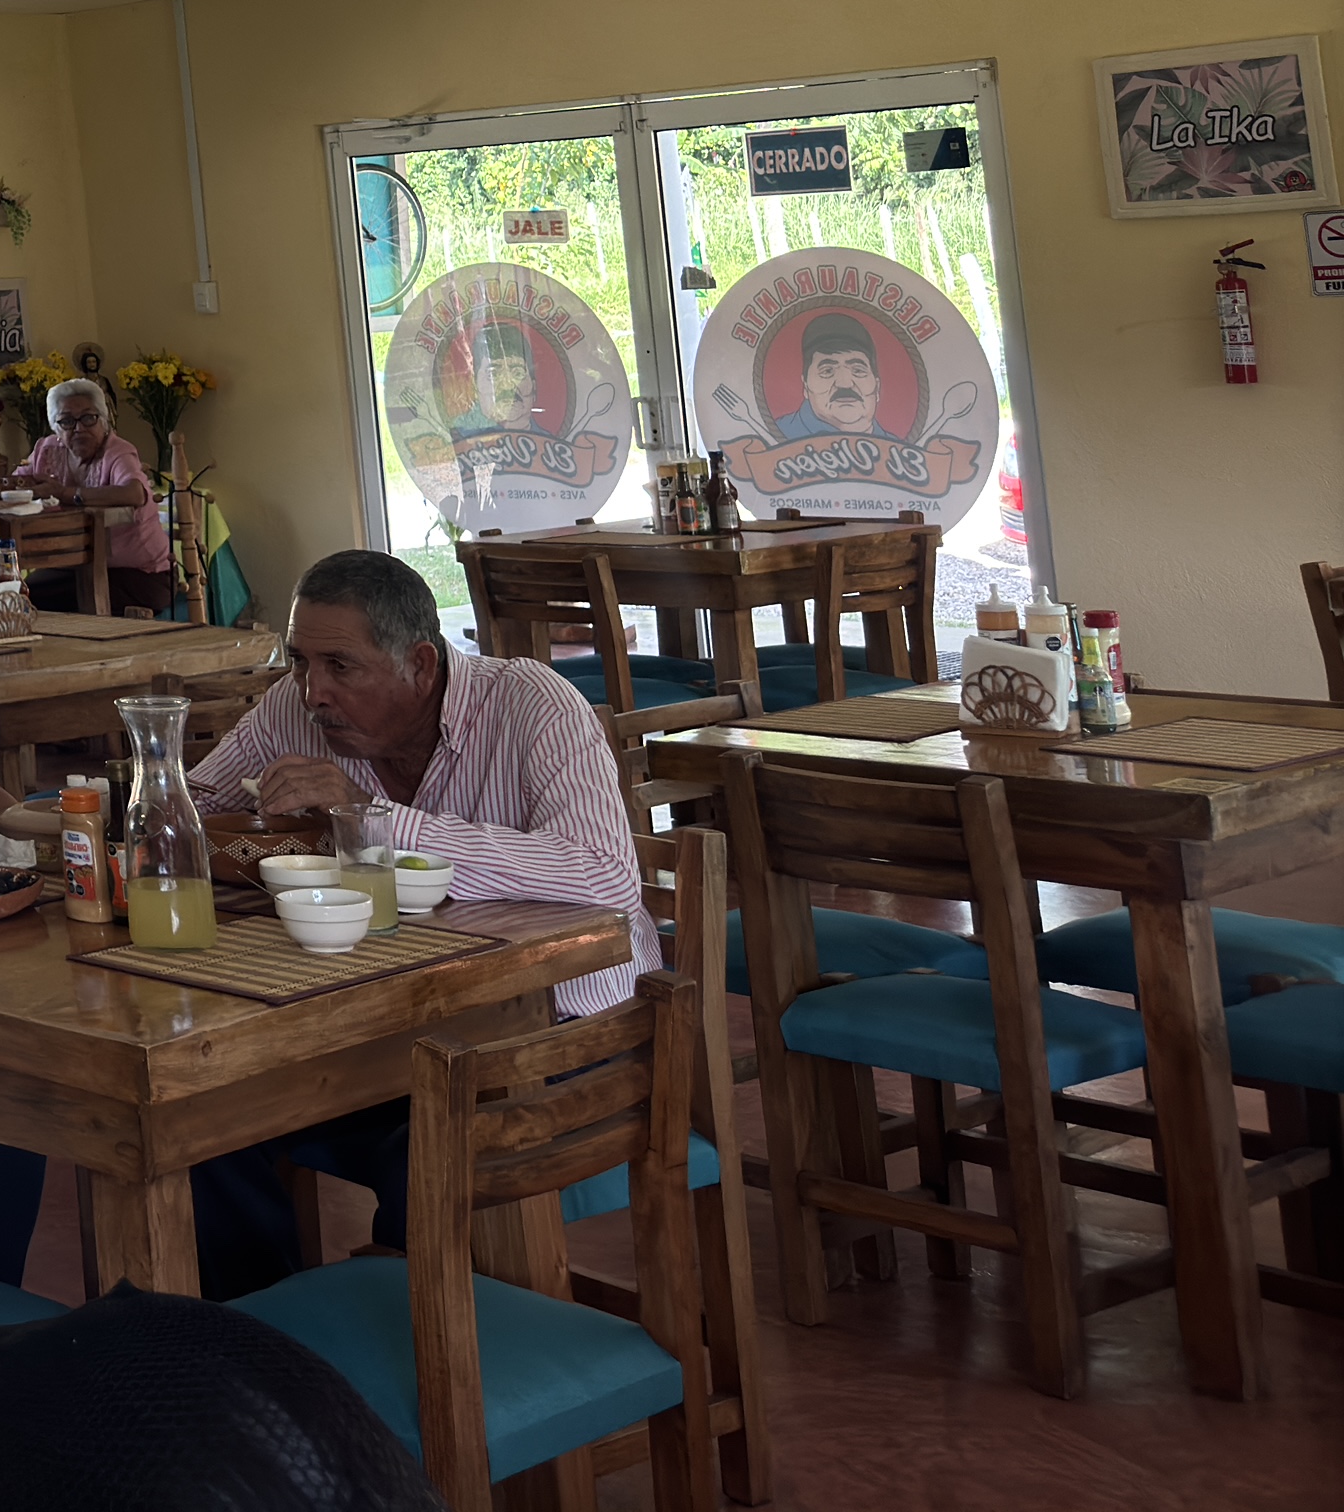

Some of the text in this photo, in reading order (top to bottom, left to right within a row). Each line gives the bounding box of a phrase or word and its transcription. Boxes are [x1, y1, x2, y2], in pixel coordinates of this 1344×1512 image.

[1150, 105, 1275, 151] La Ika
[752, 144, 848, 176] CERRADO
[508, 220, 564, 236] JALE
[1325, 281, 1344, 291] FU
